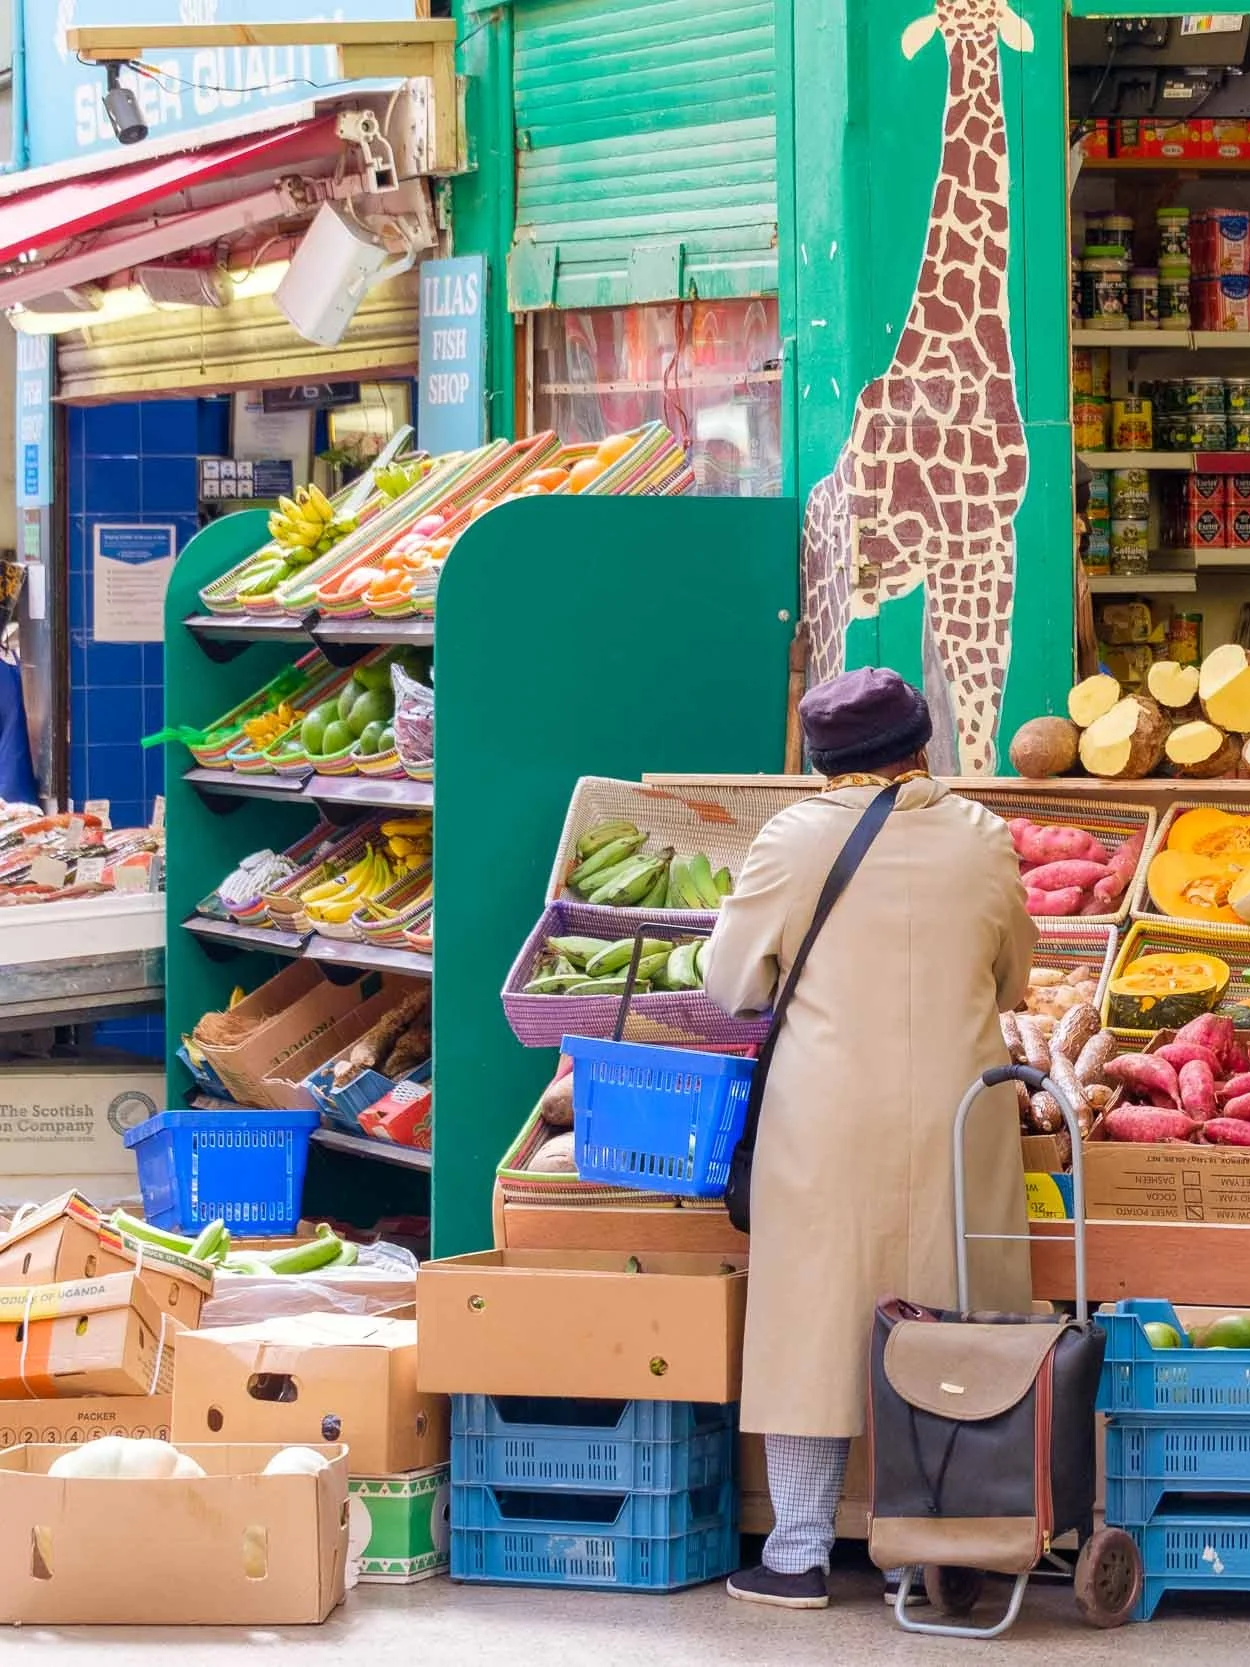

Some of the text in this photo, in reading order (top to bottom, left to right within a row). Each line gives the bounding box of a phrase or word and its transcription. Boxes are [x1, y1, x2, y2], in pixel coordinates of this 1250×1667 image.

[424, 272, 477, 317] ILIAS
[432, 328, 467, 361] FISH
[428, 373, 470, 405] SHOP
[0, 1104, 94, 1117] The Scottish
[17, 1120, 95, 1134] Company
[1135, 1175, 1176, 1185] DASHEEN
[1220, 1177, 1242, 1187] YAM
[1146, 1191, 1177, 1201] COCOA
[1219, 1194, 1239, 1203] YAM
[1115, 1206, 1178, 1217] SWEET POTATO
[1216, 1210, 1237, 1219] YAM
[60, 1284, 105, 1299] UGANDA
[77, 1412, 116, 1421] PACKER
[2, 1431, 9, 1444] 1
[24, 1431, 33, 1443] 2
[47, 1431, 56, 1443] 3
[70, 1431, 79, 1443] 4
[93, 1430, 101, 1442] 5
[137, 1430, 145, 1440] 7
[159, 1429, 167, 1440] 8
